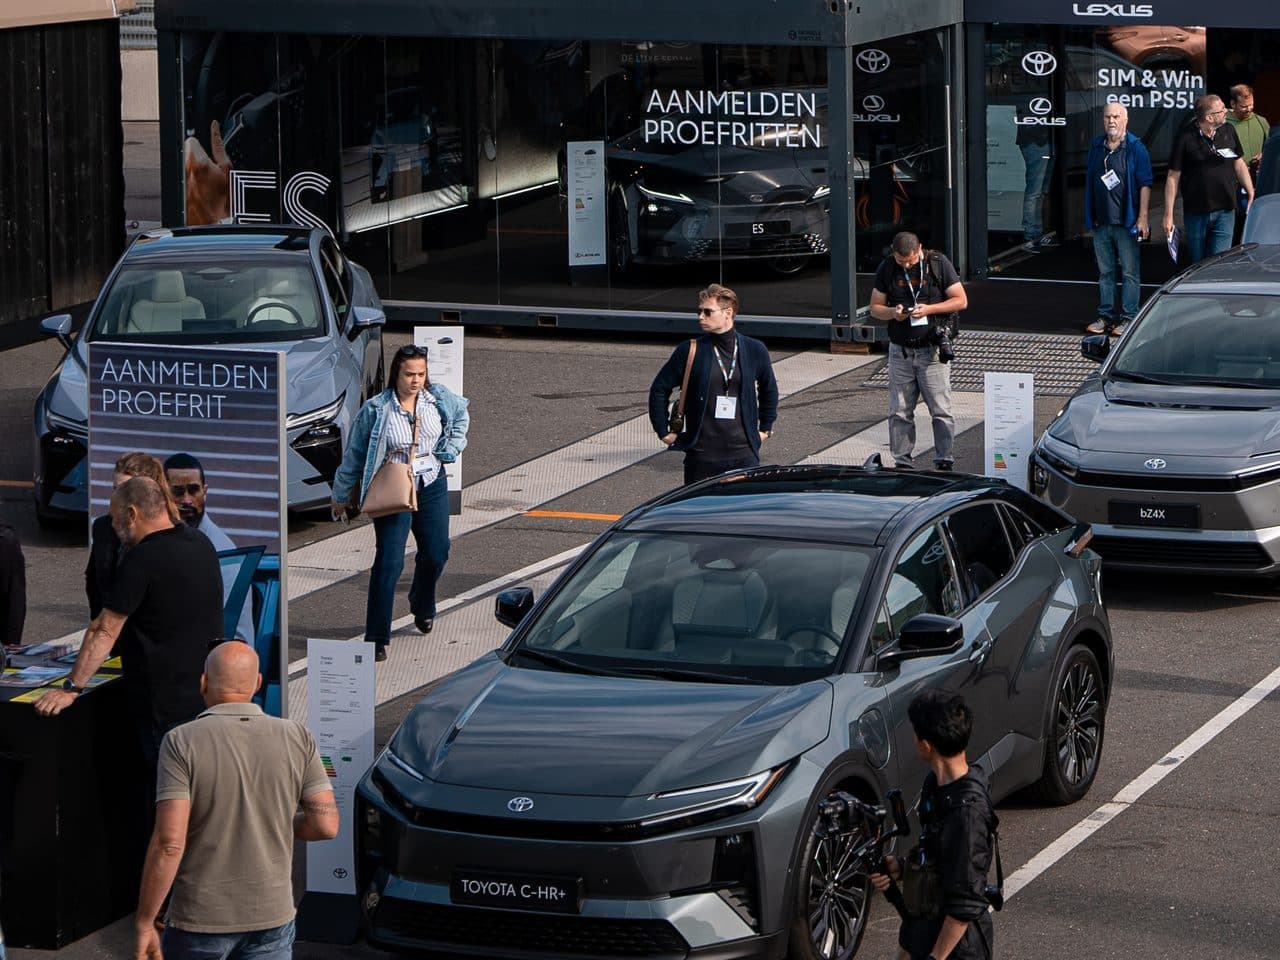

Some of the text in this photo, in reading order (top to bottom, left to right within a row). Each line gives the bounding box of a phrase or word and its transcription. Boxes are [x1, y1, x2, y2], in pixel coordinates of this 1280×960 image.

[1072, 3, 1154, 17] LEXUS
[1098, 68, 1204, 89] SIM & Win
[646, 89, 816, 118] AANMELDEN
[1106, 91, 1195, 109] een PS5!
[1014, 116, 1067, 126] LEXUS
[644, 119, 821, 149] PROEFRITTEN
[752, 223, 765, 234] ES
[100, 357, 268, 390] AANMELDEN
[102, 388, 227, 419] PROEFRIT
[1140, 507, 1165, 520] bZ4X
[461, 879, 566, 901] TOYOTA C-HR+
